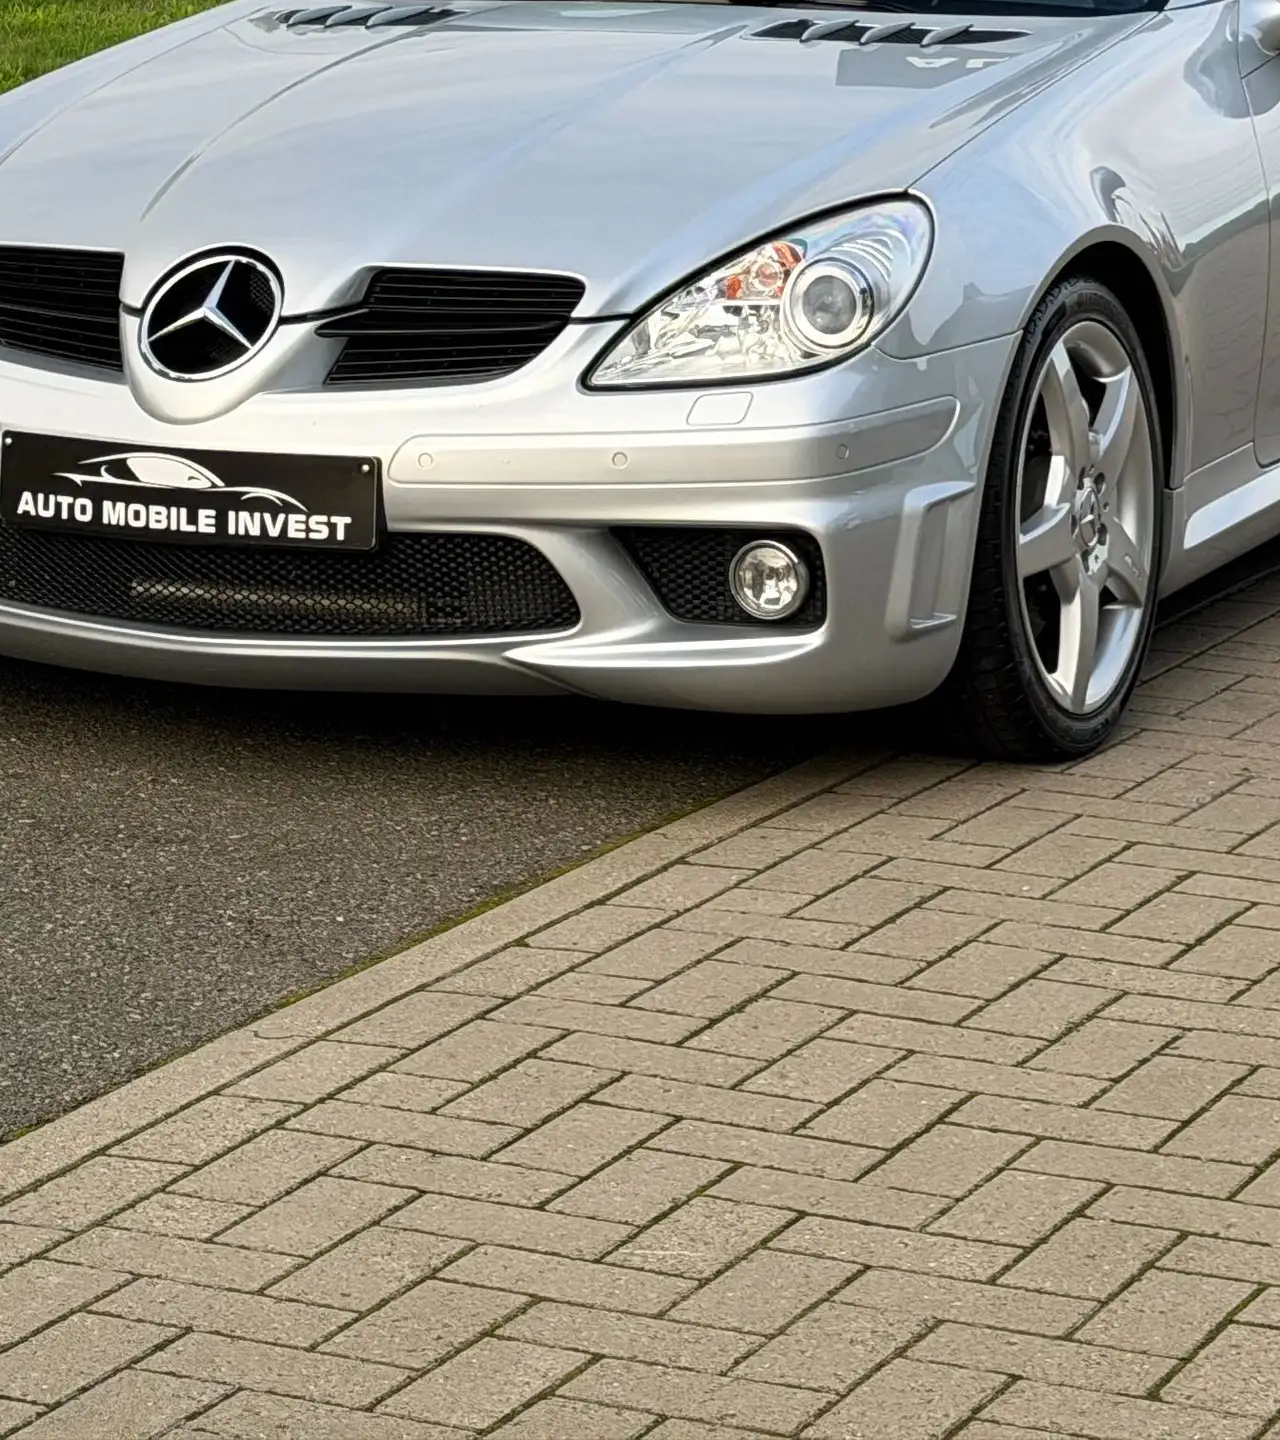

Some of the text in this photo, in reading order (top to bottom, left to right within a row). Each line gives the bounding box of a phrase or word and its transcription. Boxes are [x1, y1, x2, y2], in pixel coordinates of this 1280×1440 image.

[16, 490, 352, 542] AUTO MOBILE INVEST
